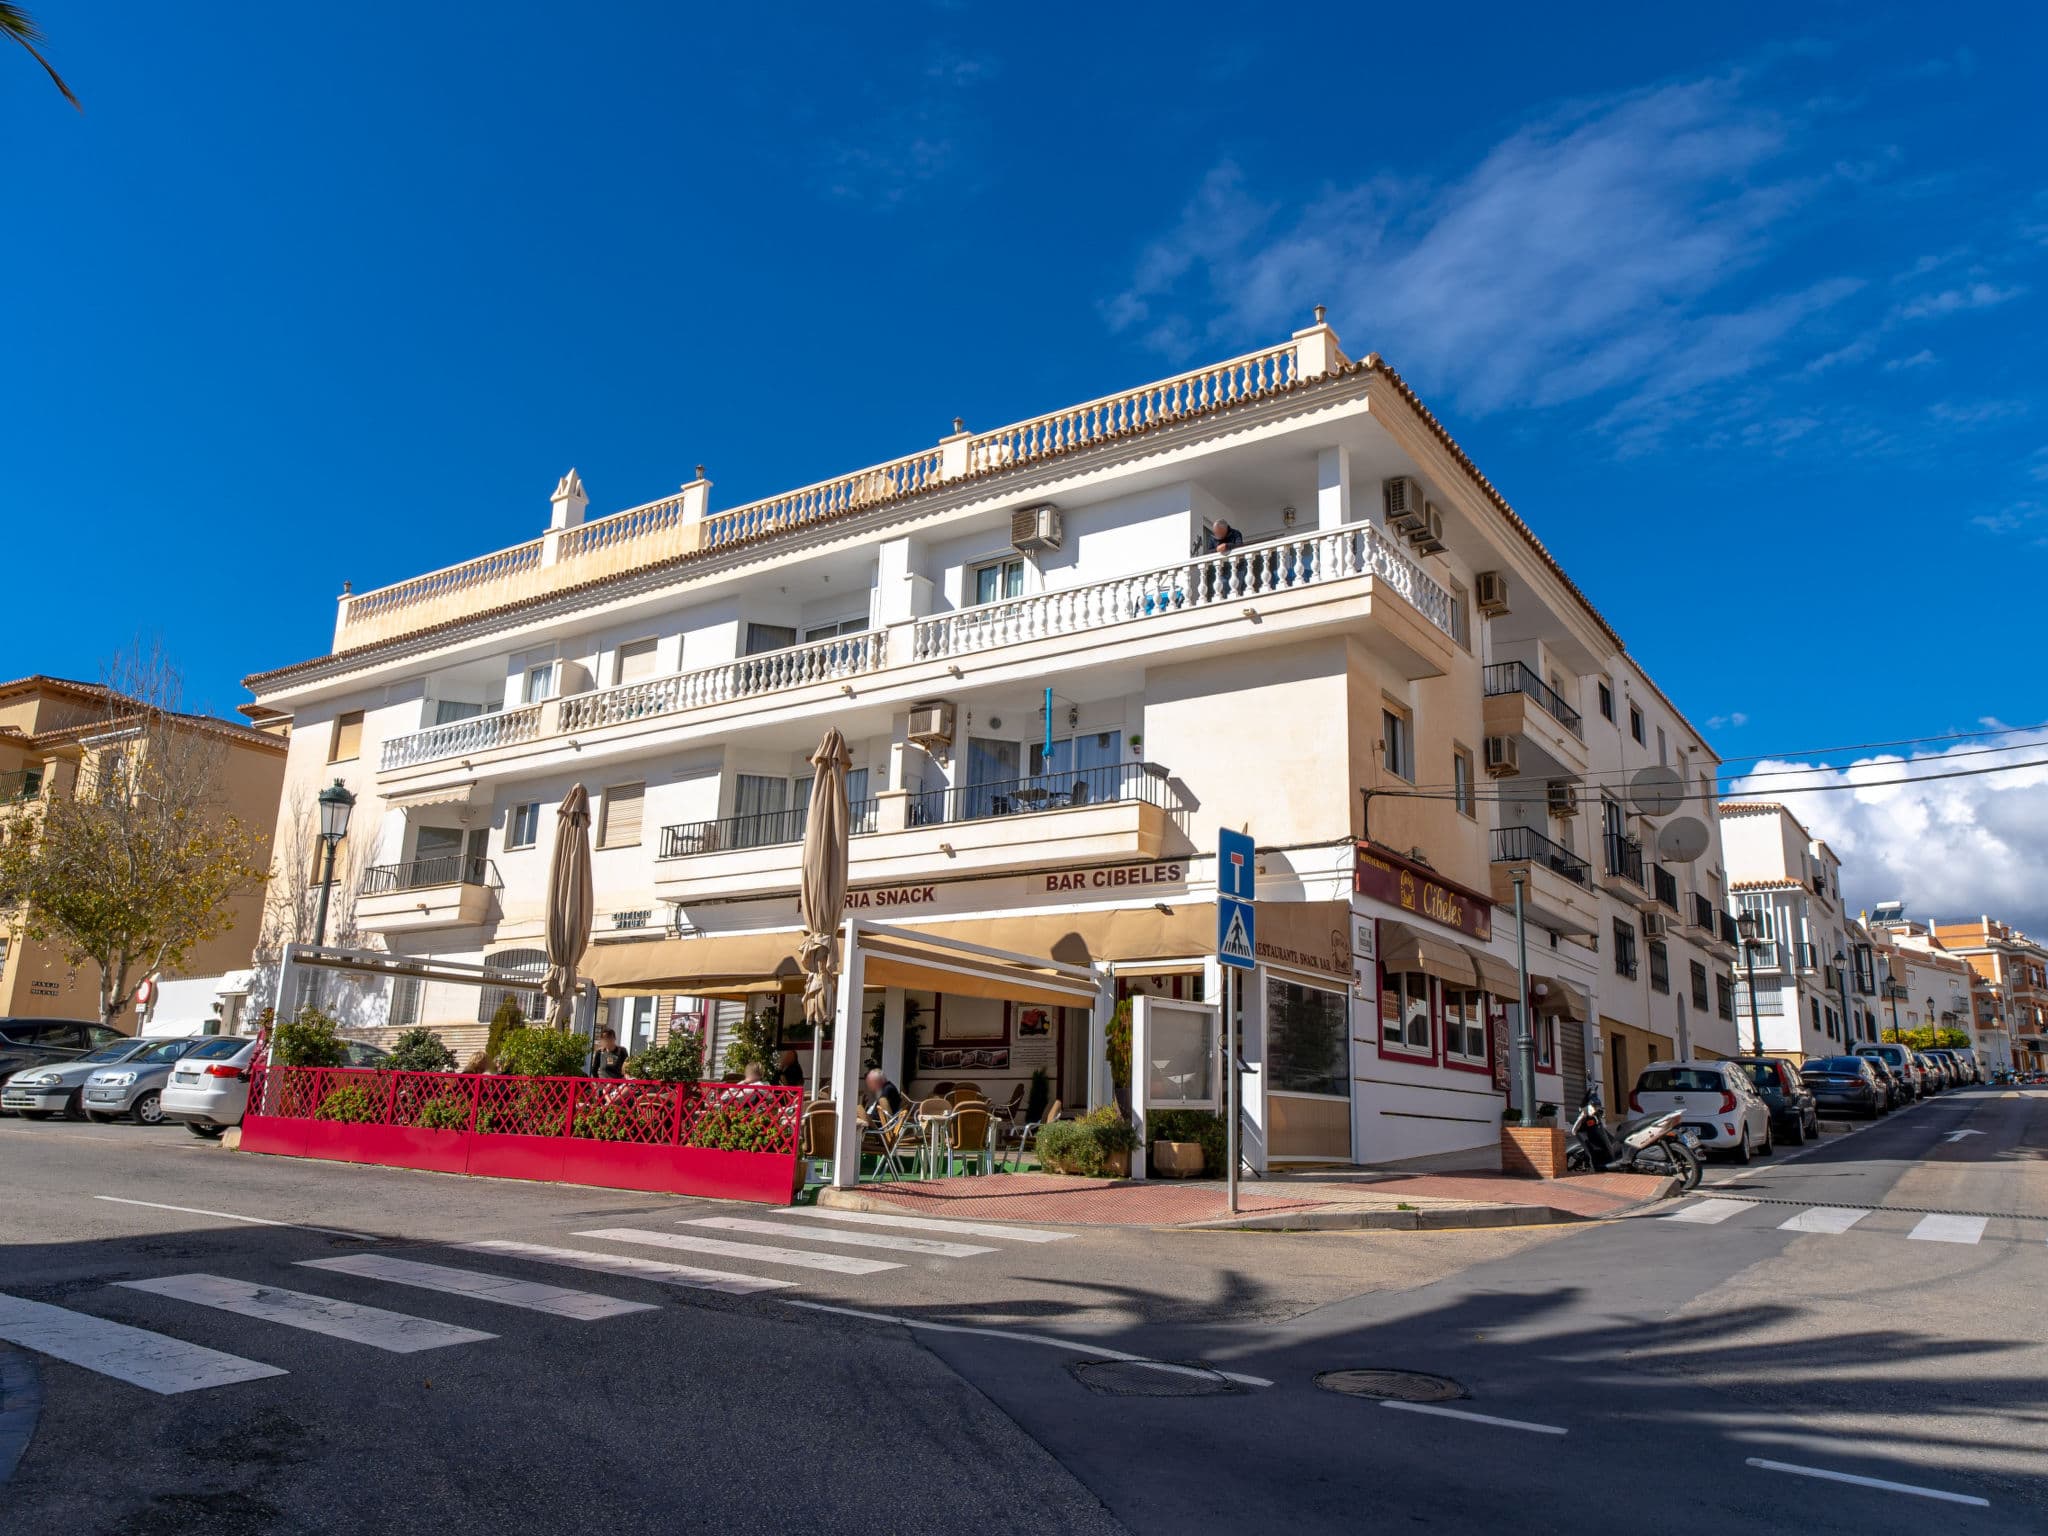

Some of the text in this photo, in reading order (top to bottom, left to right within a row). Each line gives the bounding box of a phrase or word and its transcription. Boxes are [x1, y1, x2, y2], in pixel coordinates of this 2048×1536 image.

[1046, 864, 1181, 892] BAR CIBELES
[876, 886, 935, 907] SNACK
[1423, 882, 1463, 926] Cibeles
